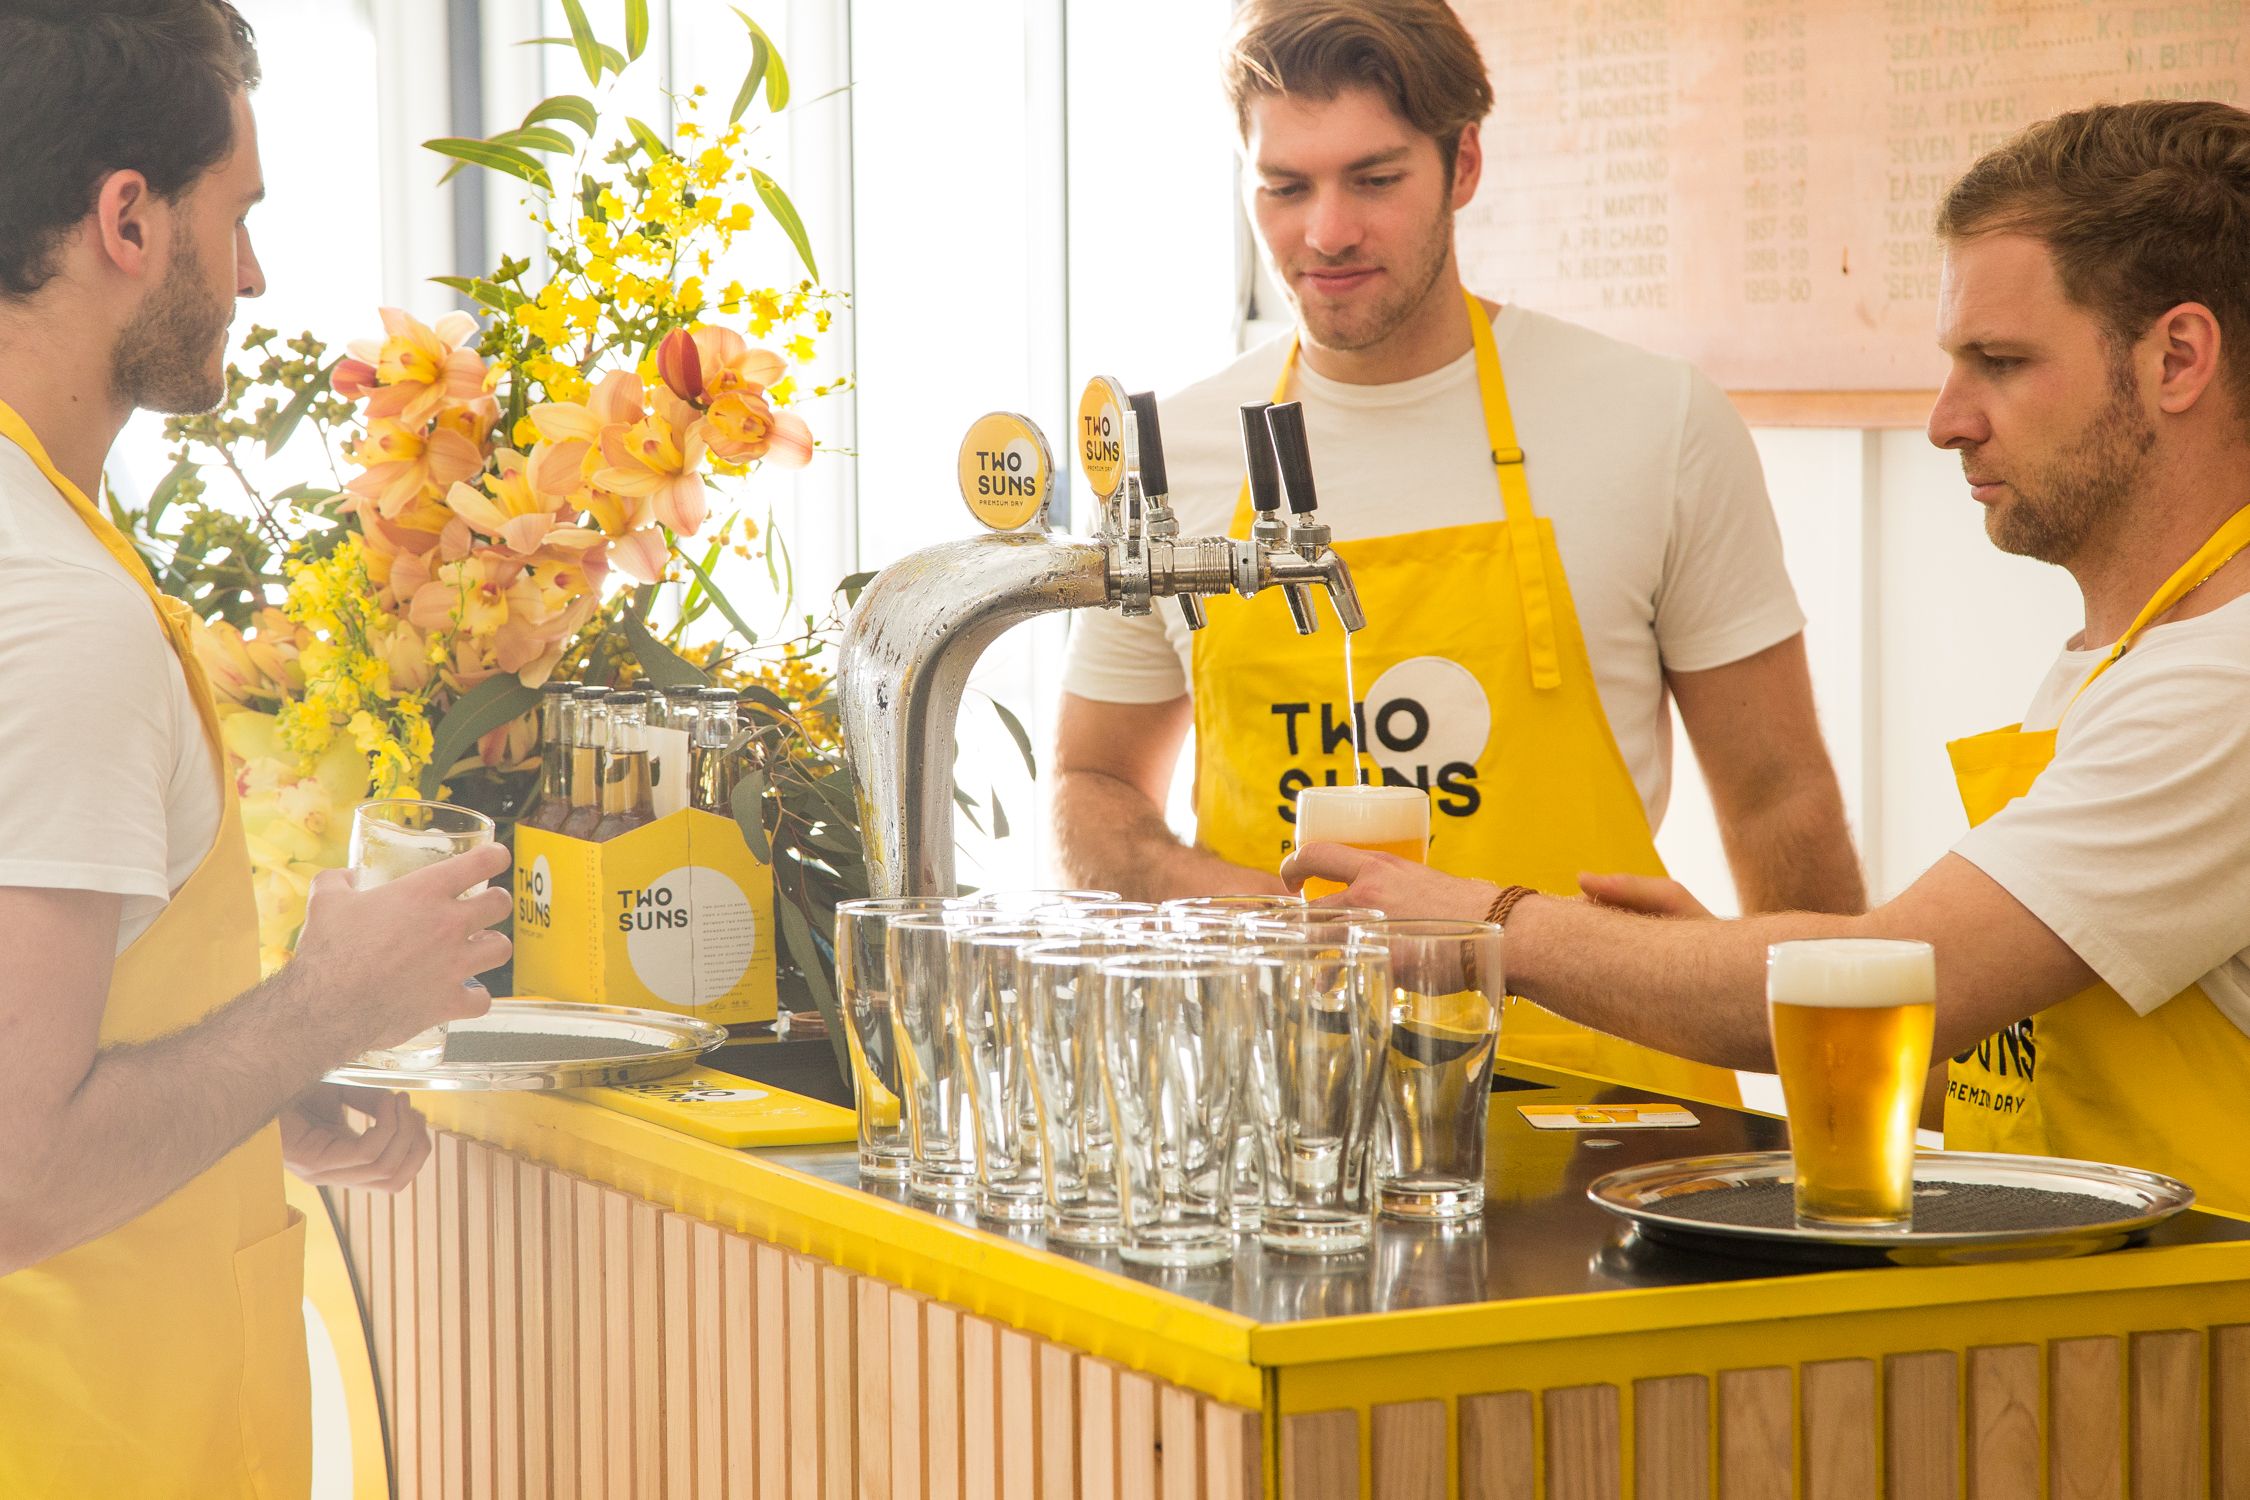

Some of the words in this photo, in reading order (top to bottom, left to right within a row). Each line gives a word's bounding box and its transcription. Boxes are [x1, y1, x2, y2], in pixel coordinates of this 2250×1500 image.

[1602, 193, 1668, 218] MARTIN
[1084, 416, 1111, 437] TWO
[976, 451, 1022, 472] TWO
[1086, 440, 1120, 462] SUNS
[978, 474, 1036, 497] SUNS
[979, 499, 1009, 507] PREMIUM
[1271, 697, 1430, 756] TWO
[519, 867, 544, 896] TWO
[617, 887, 673, 909] TWO
[518, 897, 551, 928] SUNS
[618, 909, 688, 932] SUNS
[1994, 1093, 2026, 1114] DRY
